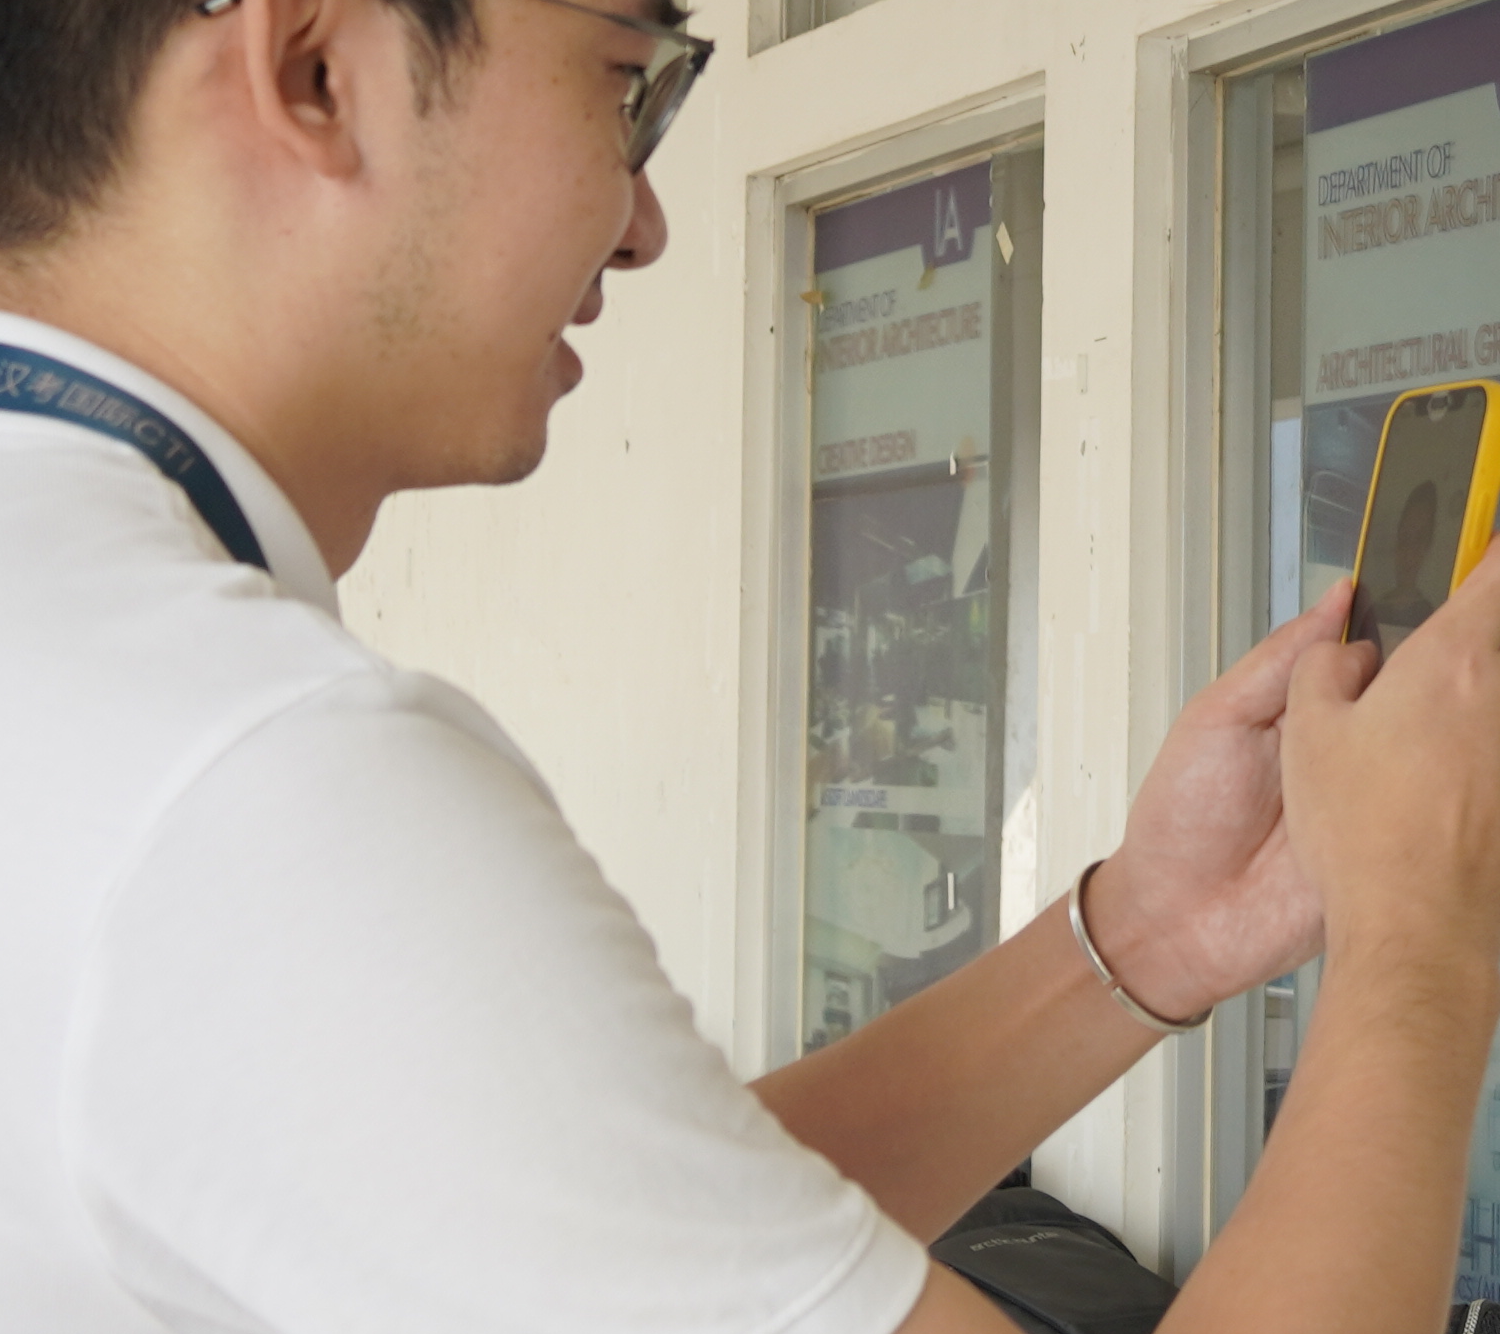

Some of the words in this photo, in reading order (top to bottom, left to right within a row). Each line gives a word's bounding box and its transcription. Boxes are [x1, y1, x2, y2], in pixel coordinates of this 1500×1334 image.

[1318, 148, 1425, 207] DEPARTMENT
[1426, 141, 1454, 179] OF
[1317, 194, 1424, 260] INTERIOR
[1316, 327, 1469, 394] ARCHITECTURAL
